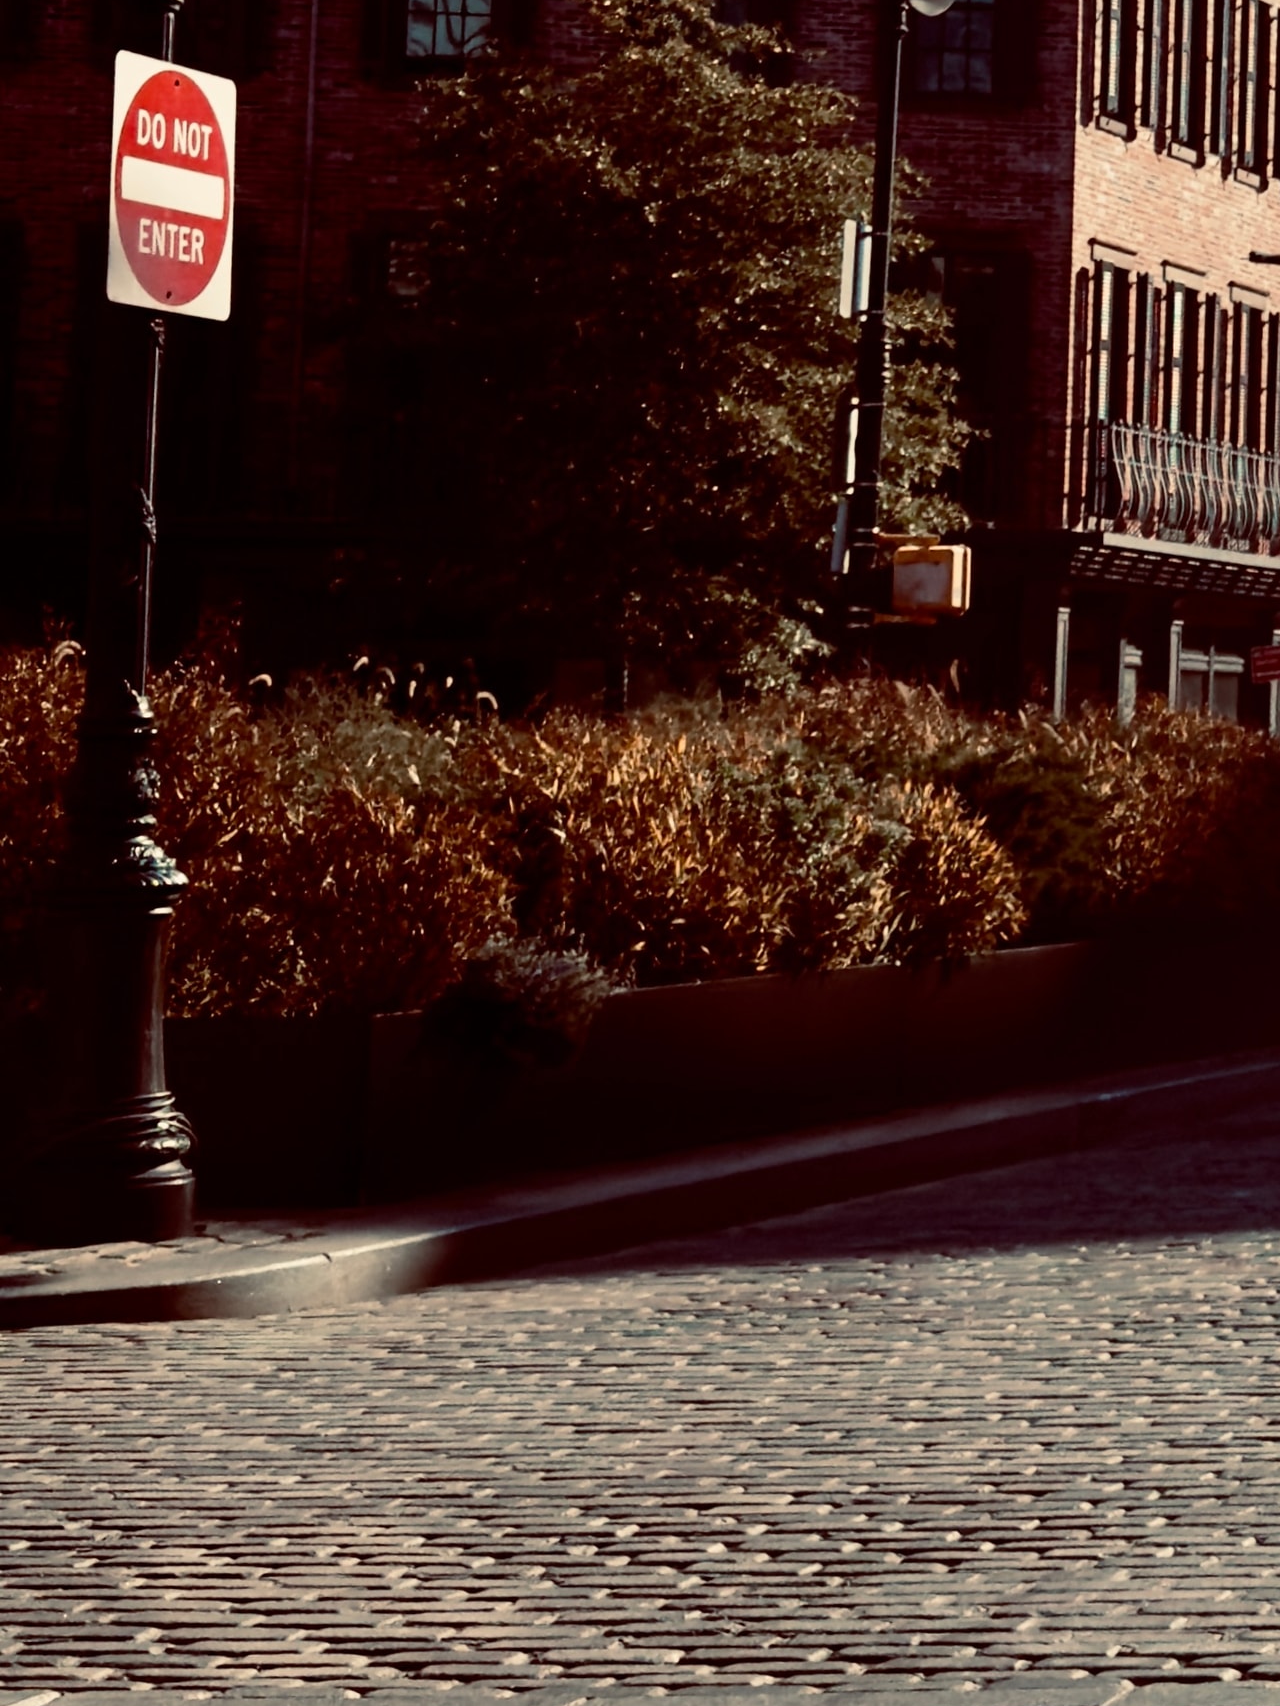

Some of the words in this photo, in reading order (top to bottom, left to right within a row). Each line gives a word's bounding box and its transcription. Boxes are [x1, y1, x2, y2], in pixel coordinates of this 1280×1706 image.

[137, 108, 166, 150] DO
[173, 118, 213, 161] NOT
[139, 218, 205, 265] ENTER
